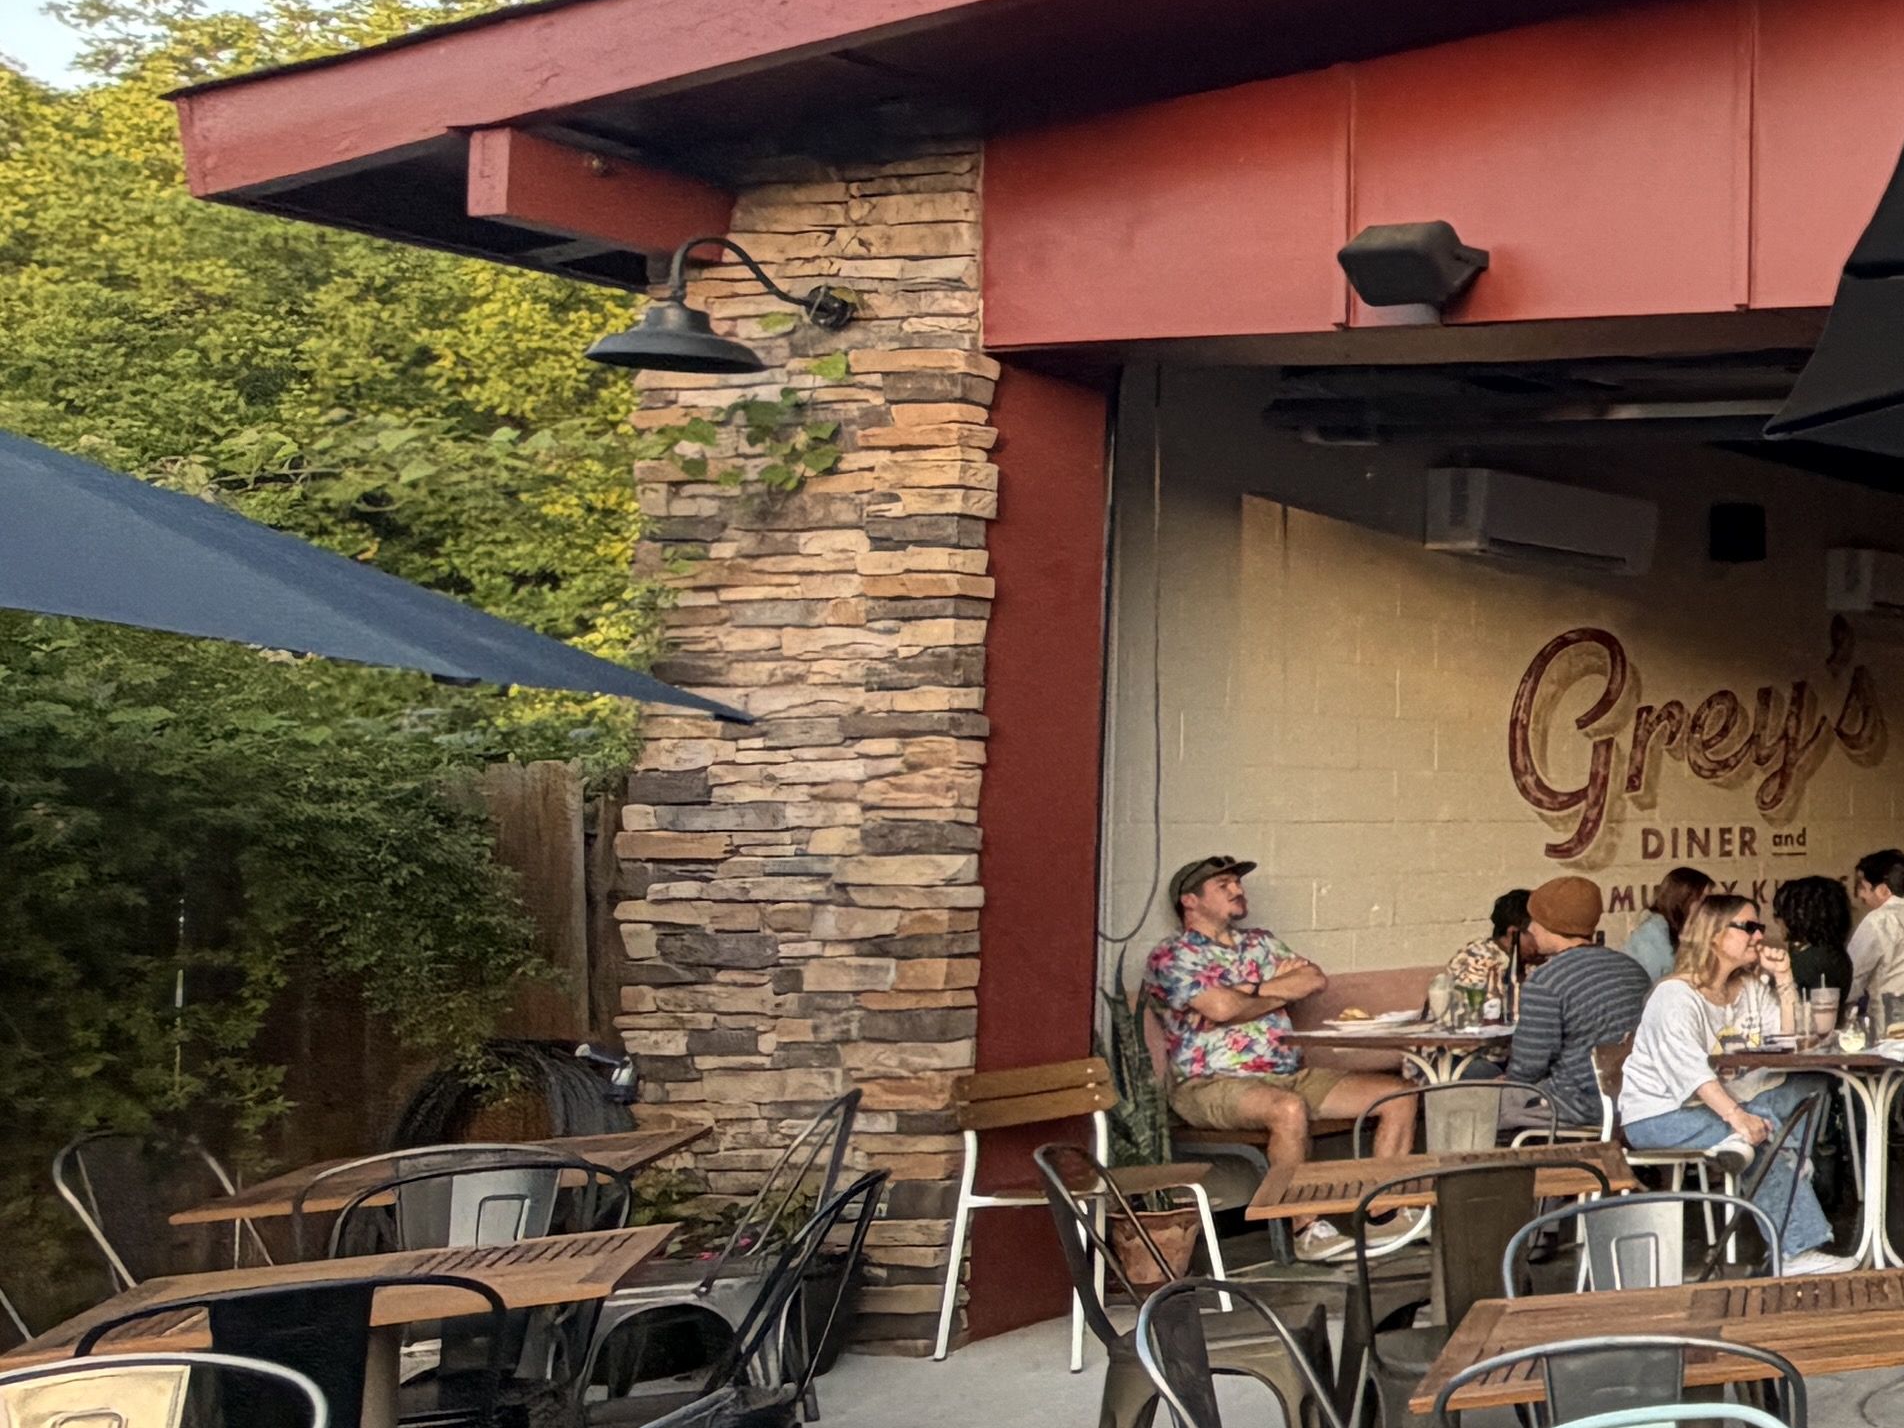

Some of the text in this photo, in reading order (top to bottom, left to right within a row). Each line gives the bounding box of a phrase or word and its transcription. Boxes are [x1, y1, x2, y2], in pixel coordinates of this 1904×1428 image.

[1508, 613, 1887, 862] Grey's
[1641, 826, 1807, 860] DINER and
